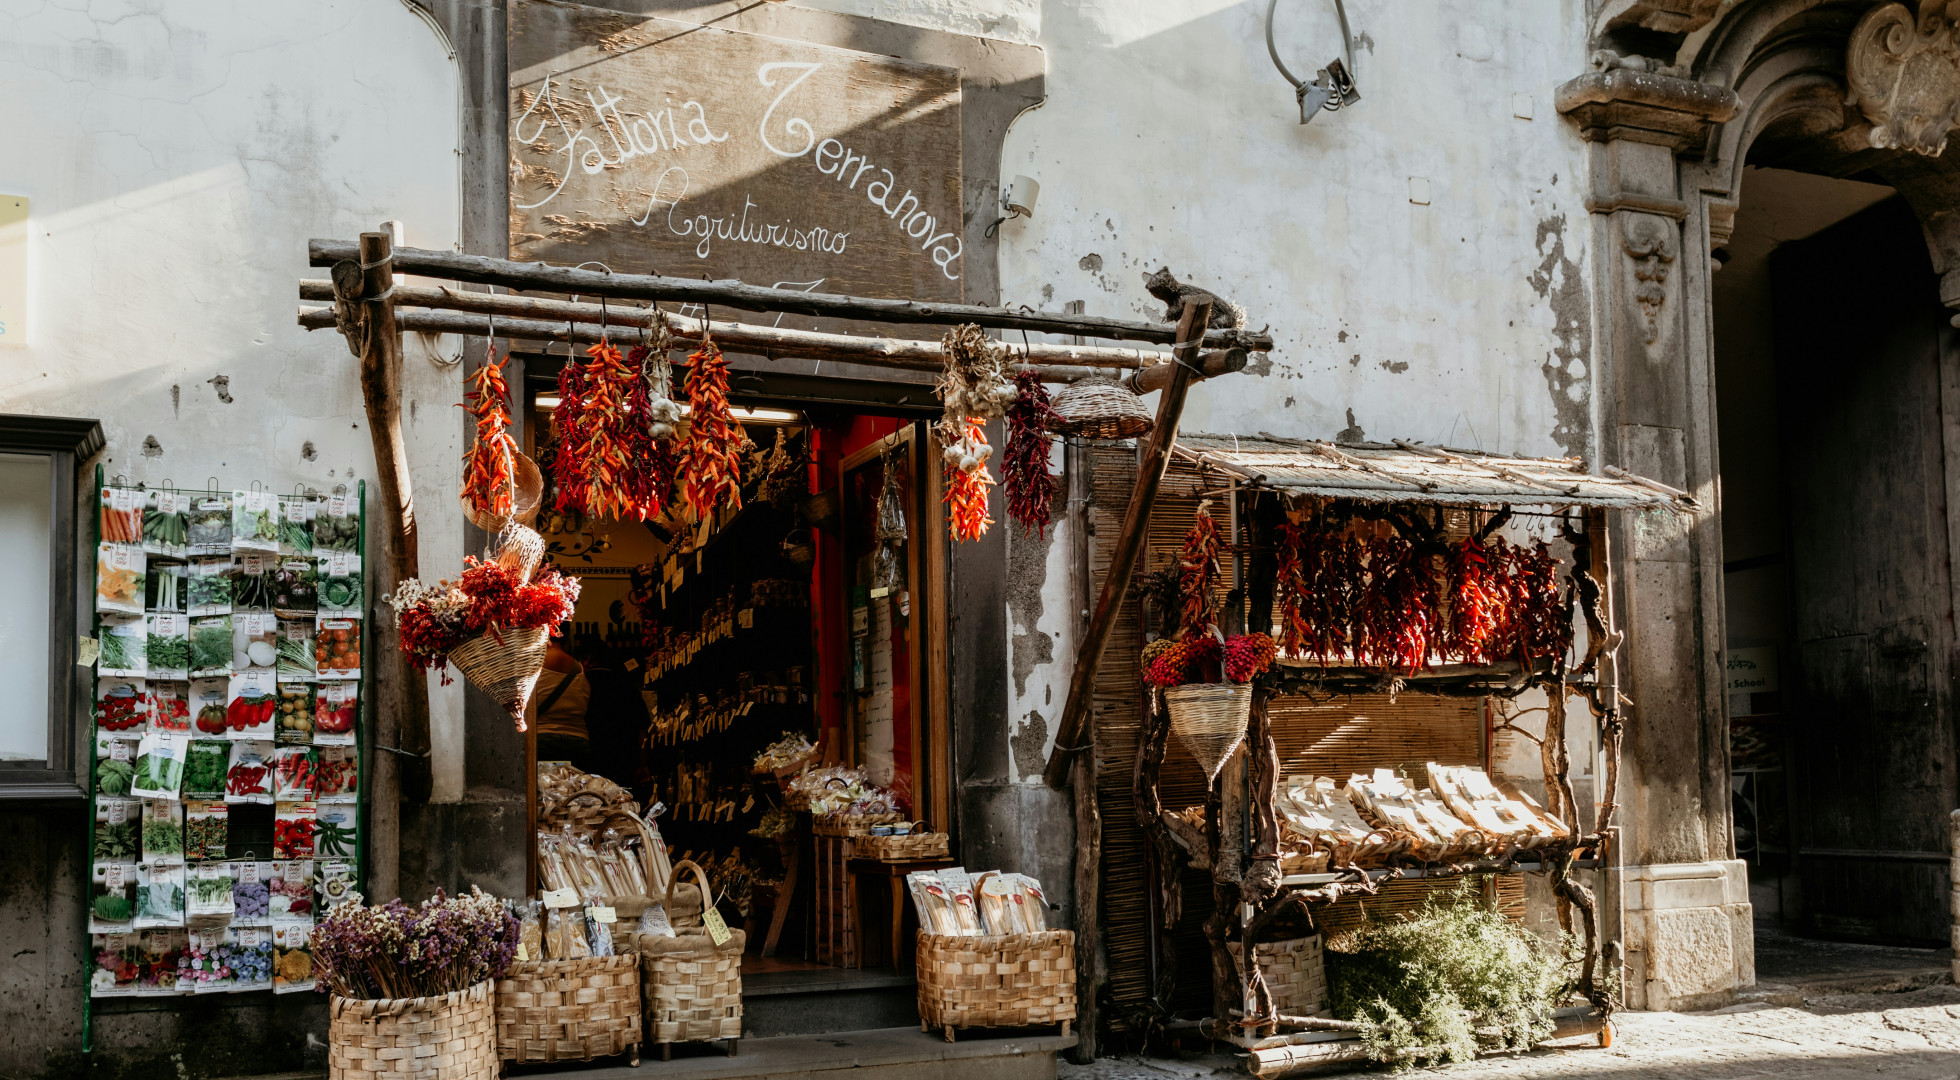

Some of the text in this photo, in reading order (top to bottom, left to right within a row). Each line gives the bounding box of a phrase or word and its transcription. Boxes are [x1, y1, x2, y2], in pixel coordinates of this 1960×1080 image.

[515, 61, 963, 281] Fattoria Terranova
[630, 166, 851, 259] Agriturismo
[1734, 677, 1765, 688] School
